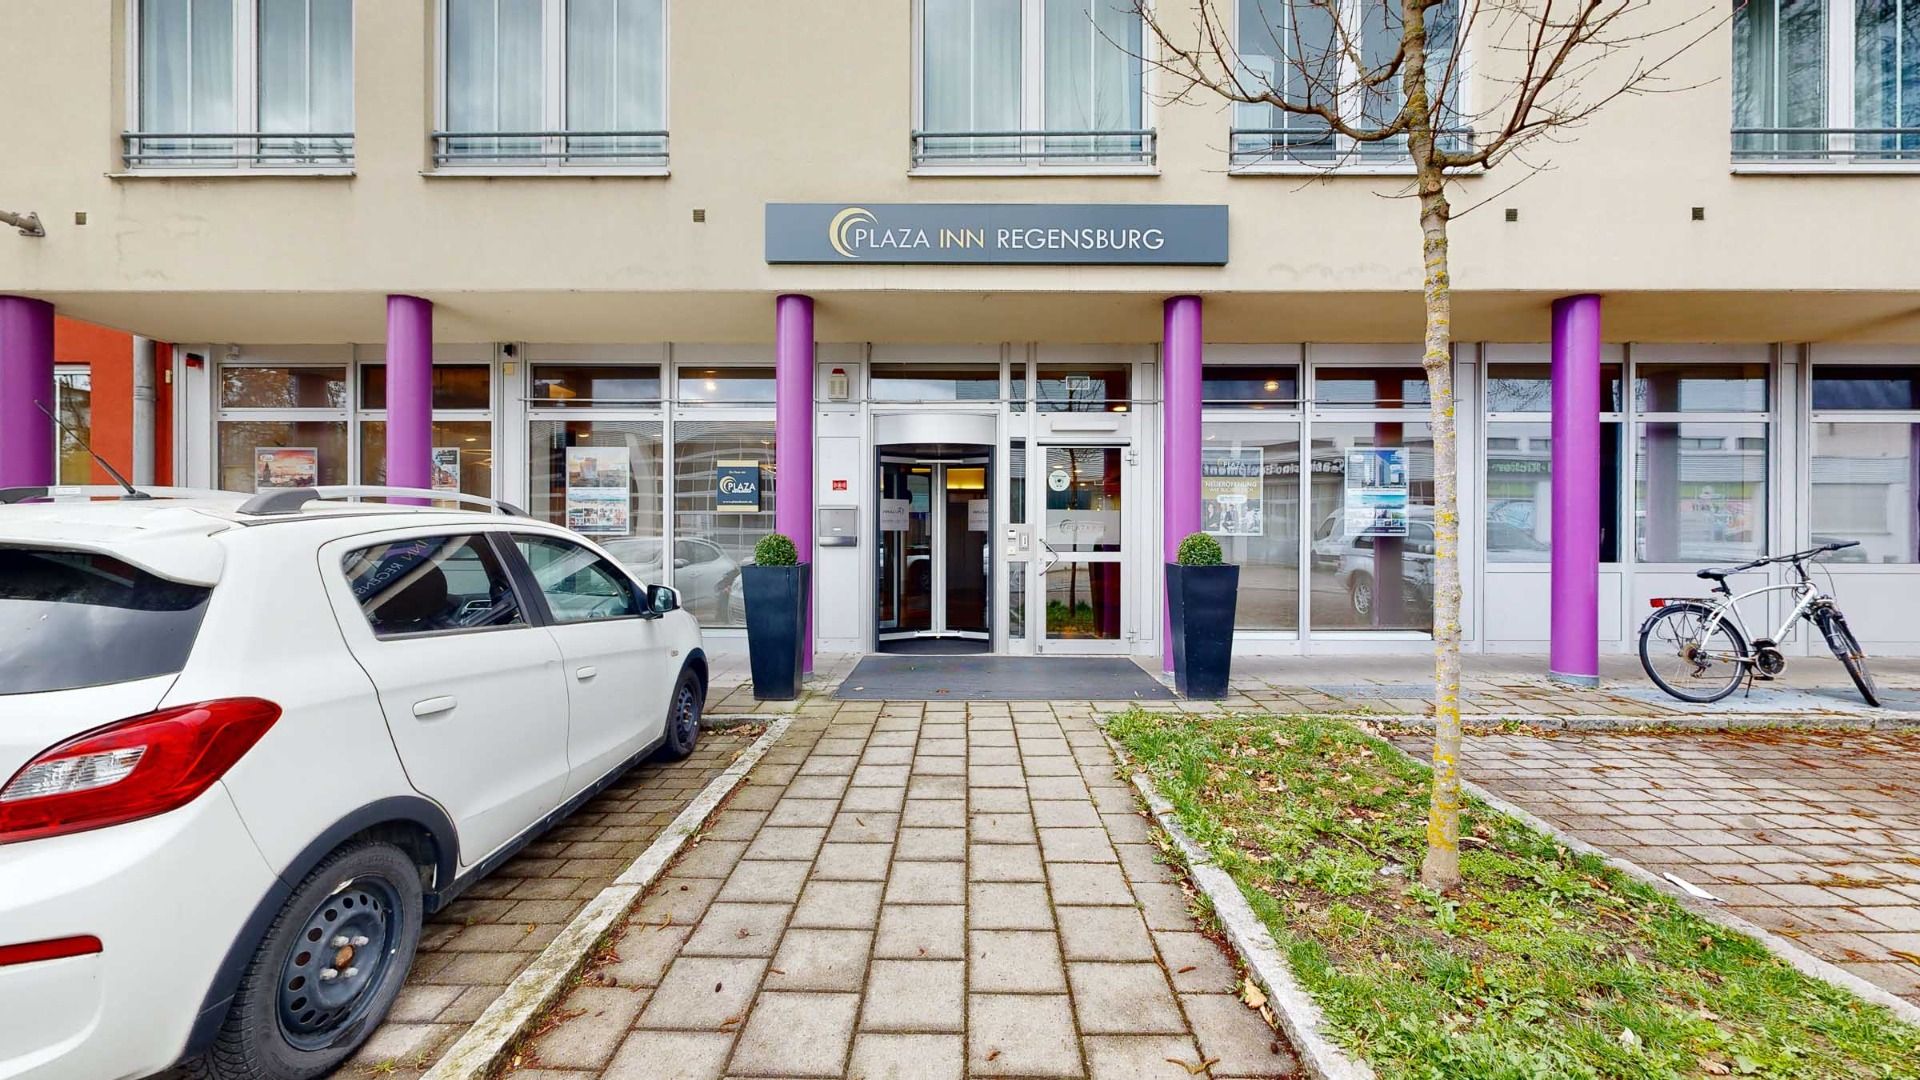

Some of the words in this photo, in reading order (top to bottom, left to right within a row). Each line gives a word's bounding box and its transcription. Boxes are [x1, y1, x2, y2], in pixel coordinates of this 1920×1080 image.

[855, 228, 930, 248] PLAZA
[939, 228, 984, 249] INN
[997, 228, 1165, 250] REGENSBURG
[728, 482, 756, 491] PLAZA
